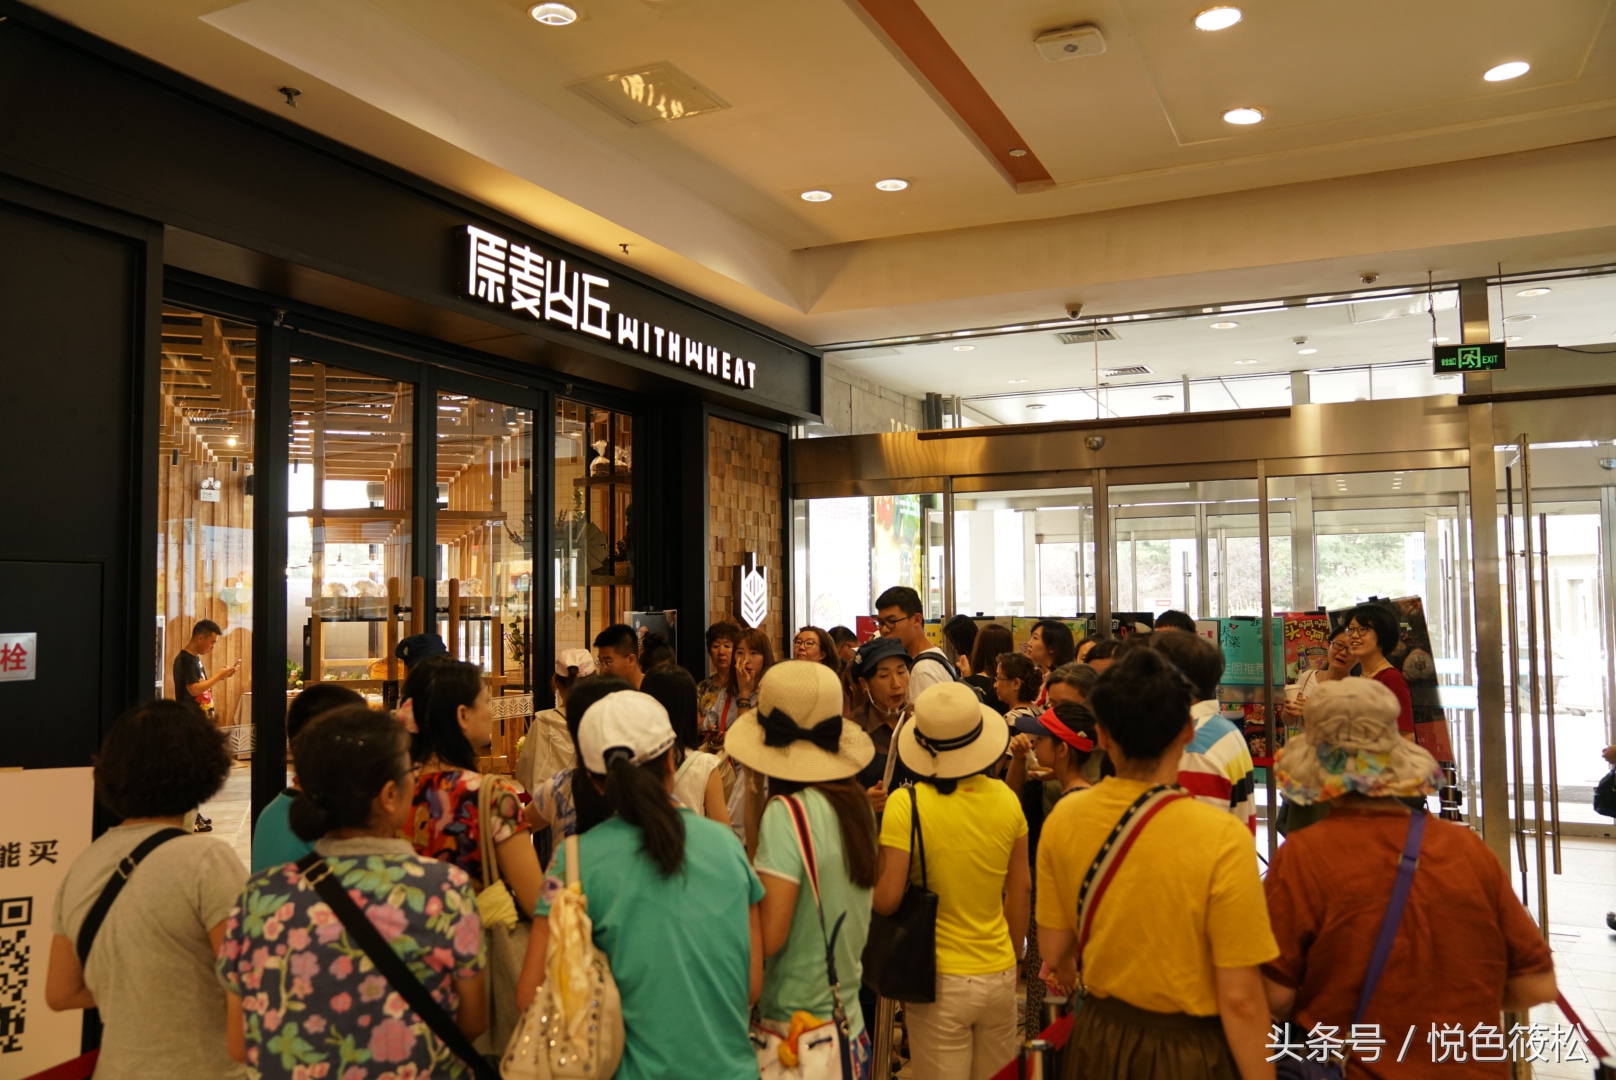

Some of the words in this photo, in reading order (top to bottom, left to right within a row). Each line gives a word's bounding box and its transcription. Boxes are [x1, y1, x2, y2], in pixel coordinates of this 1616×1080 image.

[467, 224, 611, 339] 原麦山丘
[1482, 355, 1498, 364] EXIT
[0, 642, 28, 673] 栓
[0, 839, 59, 869] 能买
